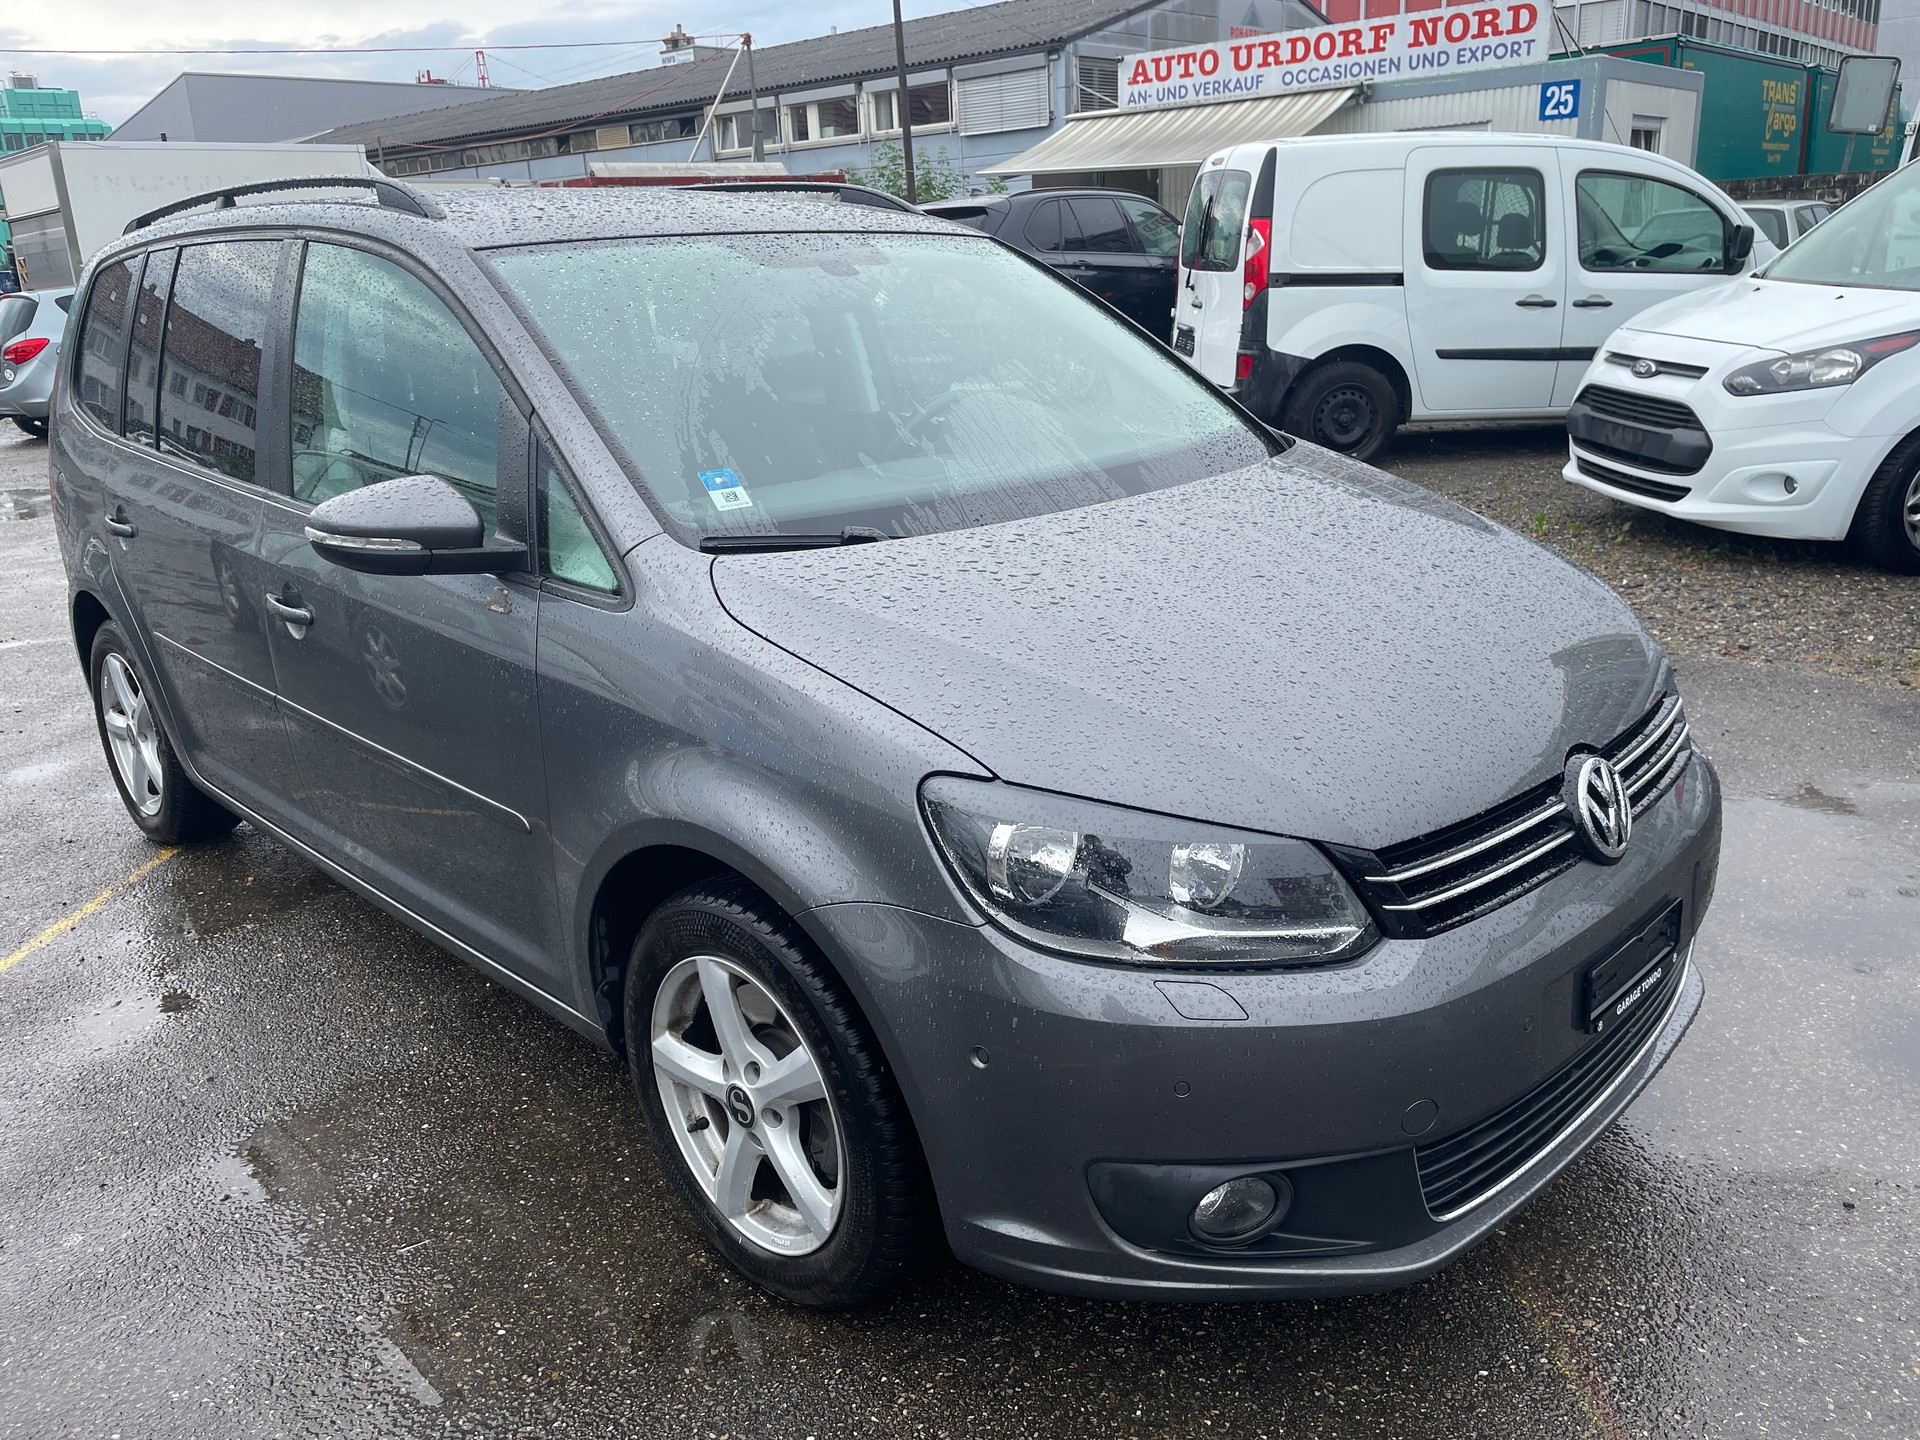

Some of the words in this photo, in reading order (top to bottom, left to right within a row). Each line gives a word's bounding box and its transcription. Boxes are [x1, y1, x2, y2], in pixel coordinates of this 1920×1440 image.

[1127, 49, 1219, 86] AUTO
[1229, 22, 1396, 72] URDORF
[1407, 3, 1538, 49] NORD
[1127, 90, 1152, 106] AN-
[1156, 84, 1188, 102] UND
[1193, 74, 1265, 98] VERKAUF
[1281, 57, 1401, 87] OCCASIONEN
[1409, 51, 1450, 70] UND
[1456, 39, 1536, 65] EXPORT
[1762, 79, 1796, 105] TRANS
[1544, 84, 1574, 116] 25
[1616, 985, 1642, 1015] GARAGE
[1642, 967, 1662, 993] TONDO
